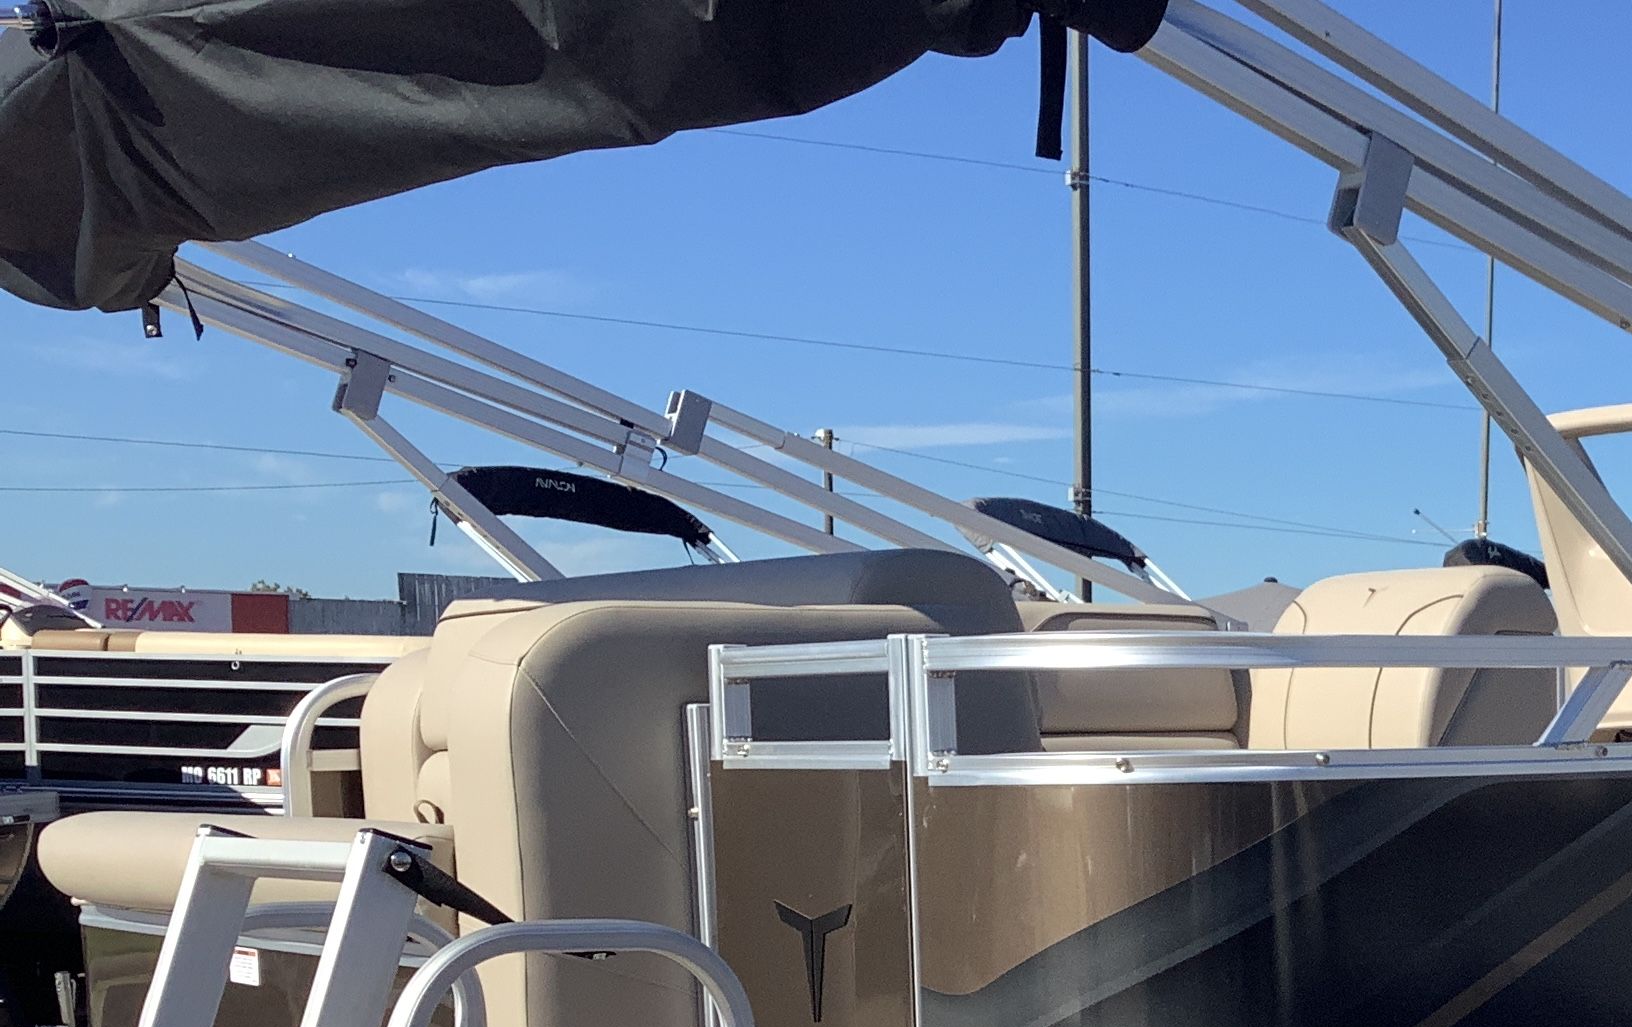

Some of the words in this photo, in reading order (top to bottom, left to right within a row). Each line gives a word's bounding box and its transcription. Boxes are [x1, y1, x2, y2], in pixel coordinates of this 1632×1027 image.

[104, 597, 196, 622] RE/MAX
[207, 766, 239, 785] 6611
[242, 767, 260, 785] RP
